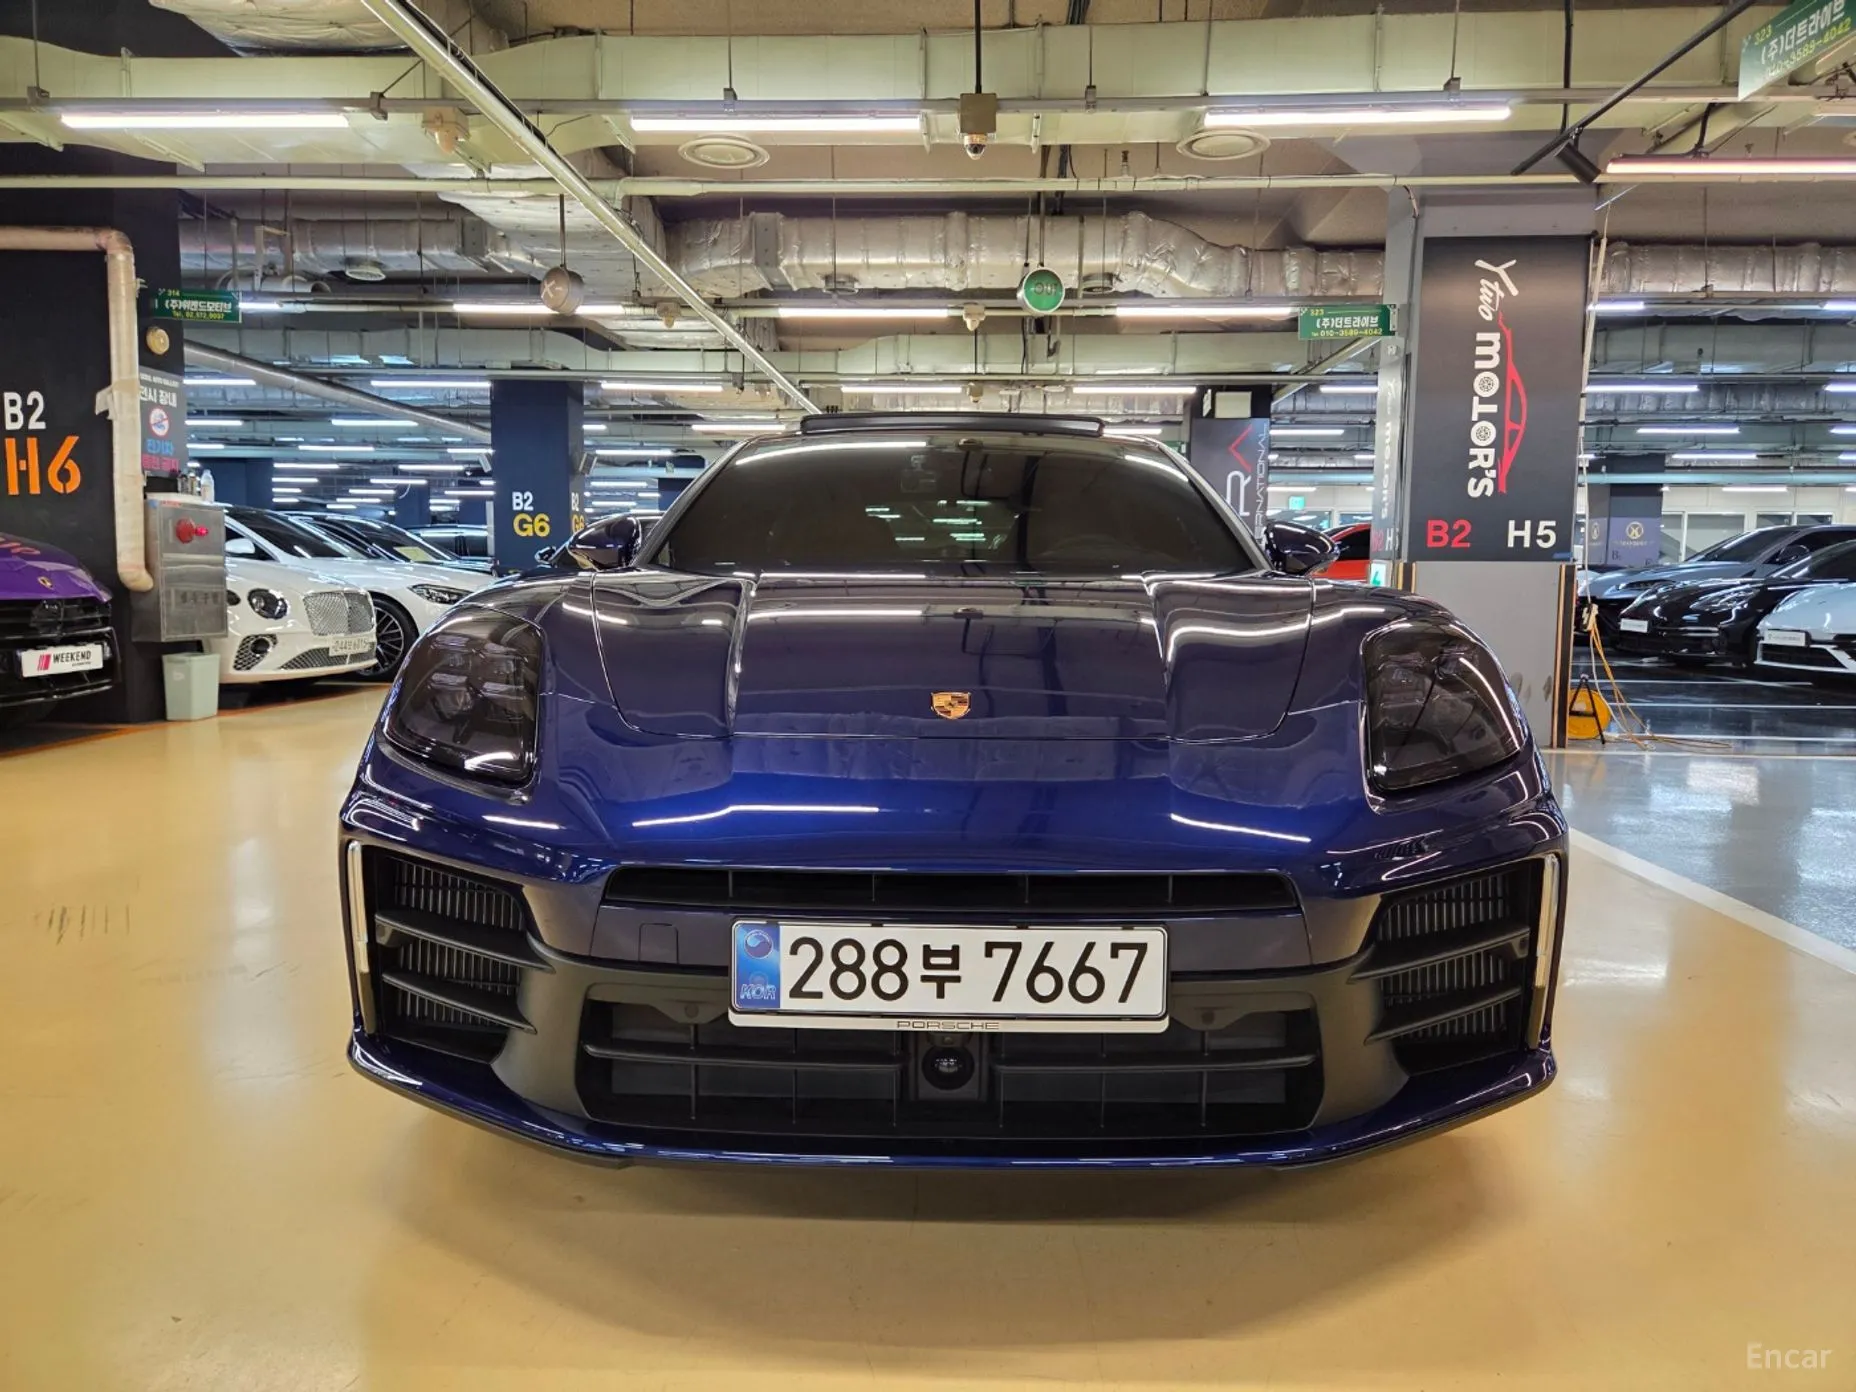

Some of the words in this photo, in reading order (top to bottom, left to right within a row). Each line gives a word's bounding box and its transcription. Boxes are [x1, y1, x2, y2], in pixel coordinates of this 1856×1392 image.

[3, 390, 47, 430] B2
[4, 435, 82, 496] H6
[512, 491, 534, 511] B2
[513, 512, 551, 537] G6
[1426, 519, 1472, 548] B2
[1507, 519, 1557, 549] H5
[53, 650, 92, 663] WEEKEND
[788, 936, 962, 1002] 288부
[984, 940, 1149, 1005] 7667
[896, 1020, 1000, 1031] PORSCHE
